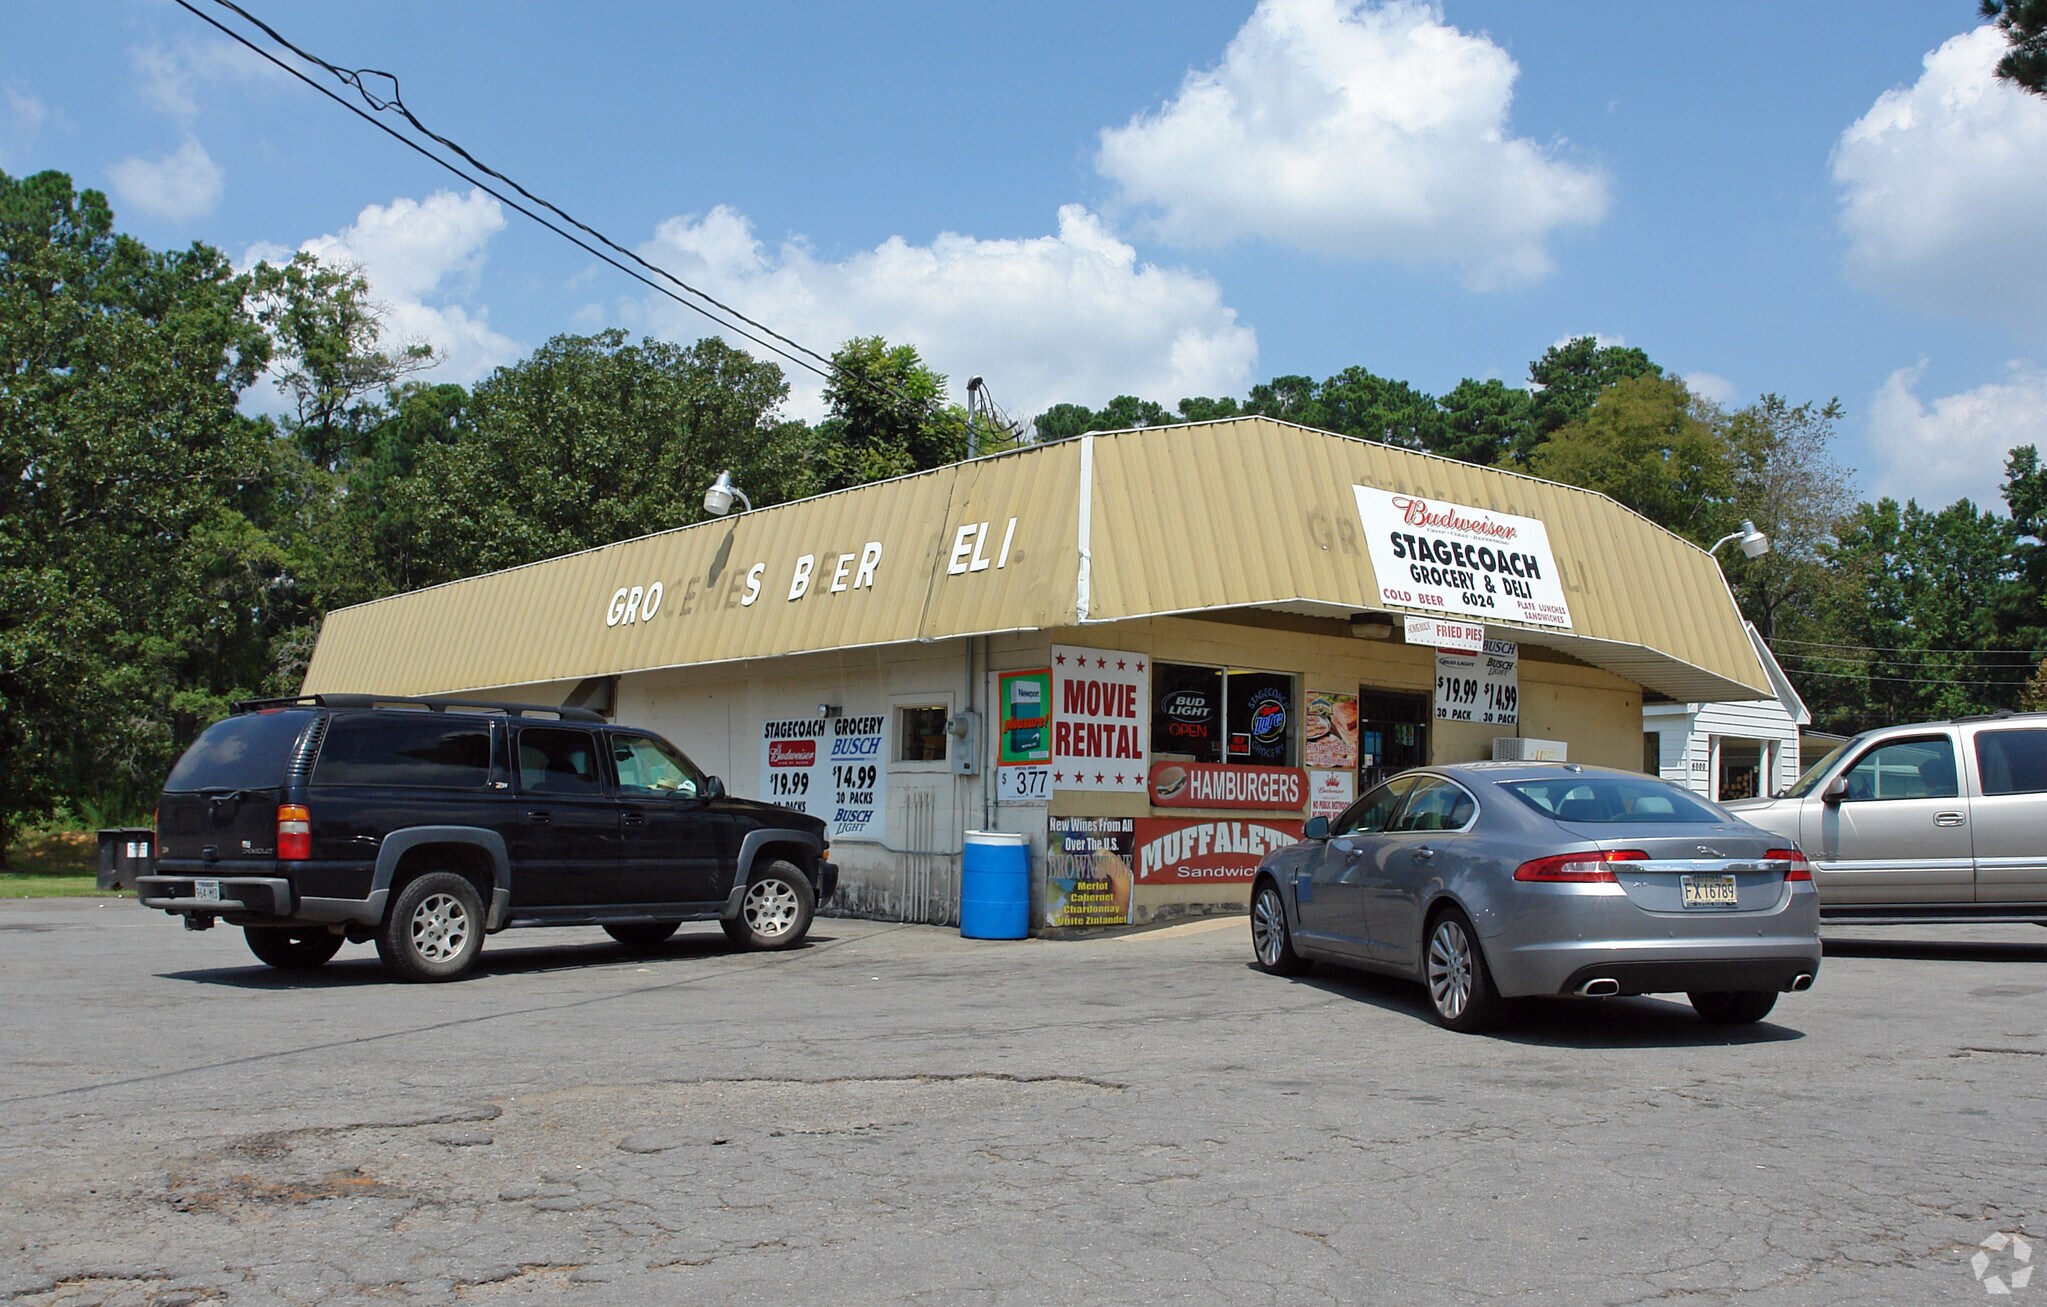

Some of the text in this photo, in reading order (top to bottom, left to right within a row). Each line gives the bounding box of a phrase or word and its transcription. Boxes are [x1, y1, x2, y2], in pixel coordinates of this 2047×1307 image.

[1392, 496, 1518, 540] Budweiser
[1390, 531, 1541, 580] STAGECOACH
[787, 541, 884, 602] BEER
[1410, 563, 1532, 599] GROCERY & DELI
[1383, 588, 1445, 607] COLD BEER
[1462, 592, 1495, 608] 6024
[1517, 600, 1566, 615] PLATE LUNCHES
[1524, 611, 1565, 624] SANDWICHES
[1436, 624, 1483, 642] FRIED PIES
[1483, 640, 1517, 655] BUSCH
[1486, 658, 1514, 670] BUSCH
[1488, 668, 1509, 676] LIGHT
[1017, 688, 1040, 698] Newport
[1063, 679, 1137, 718] MOVIE
[1248, 687, 1289, 710] STAGECOACH
[1484, 682, 1517, 712] $14.99
[1175, 696, 1206, 706] BUD
[1168, 705, 1211, 717] LIGHT
[1437, 708, 1472, 720] 30 PACK
[1483, 712, 1516, 724] 30 PACK
[764, 719, 826, 739] STAGECOACH
[834, 716, 885, 736] GROCERY
[1168, 722, 1208, 737] OPEN
[1253, 713, 1284, 735] Lite
[830, 737, 882, 755] BUSCH
[1055, 721, 1143, 760] RENTAL
[769, 744, 815, 762] Budweiser
[1251, 740, 1285, 758] GROCERY
[770, 772, 809, 796] $19.99
[832, 765, 877, 790] $14.99
[1002, 770, 1048, 796] $ 3.77
[1190, 769, 1299, 803] HAMBURGERS
[836, 791, 874, 805] 30 PACKS
[834, 808, 874, 823] BUSCH
[835, 823, 866, 835] LIGHT
[1050, 817, 1133, 832] New Wines From All
[1065, 837, 1119, 851] Over The U.S.
[1177, 865, 1257, 878] Sandwic
[1078, 881, 1108, 890] Merlot
[1071, 893, 1114, 902] Cabernet
[1063, 905, 1120, 914] Chardonnay
[1054, 915, 1127, 926] White Zinfandel
